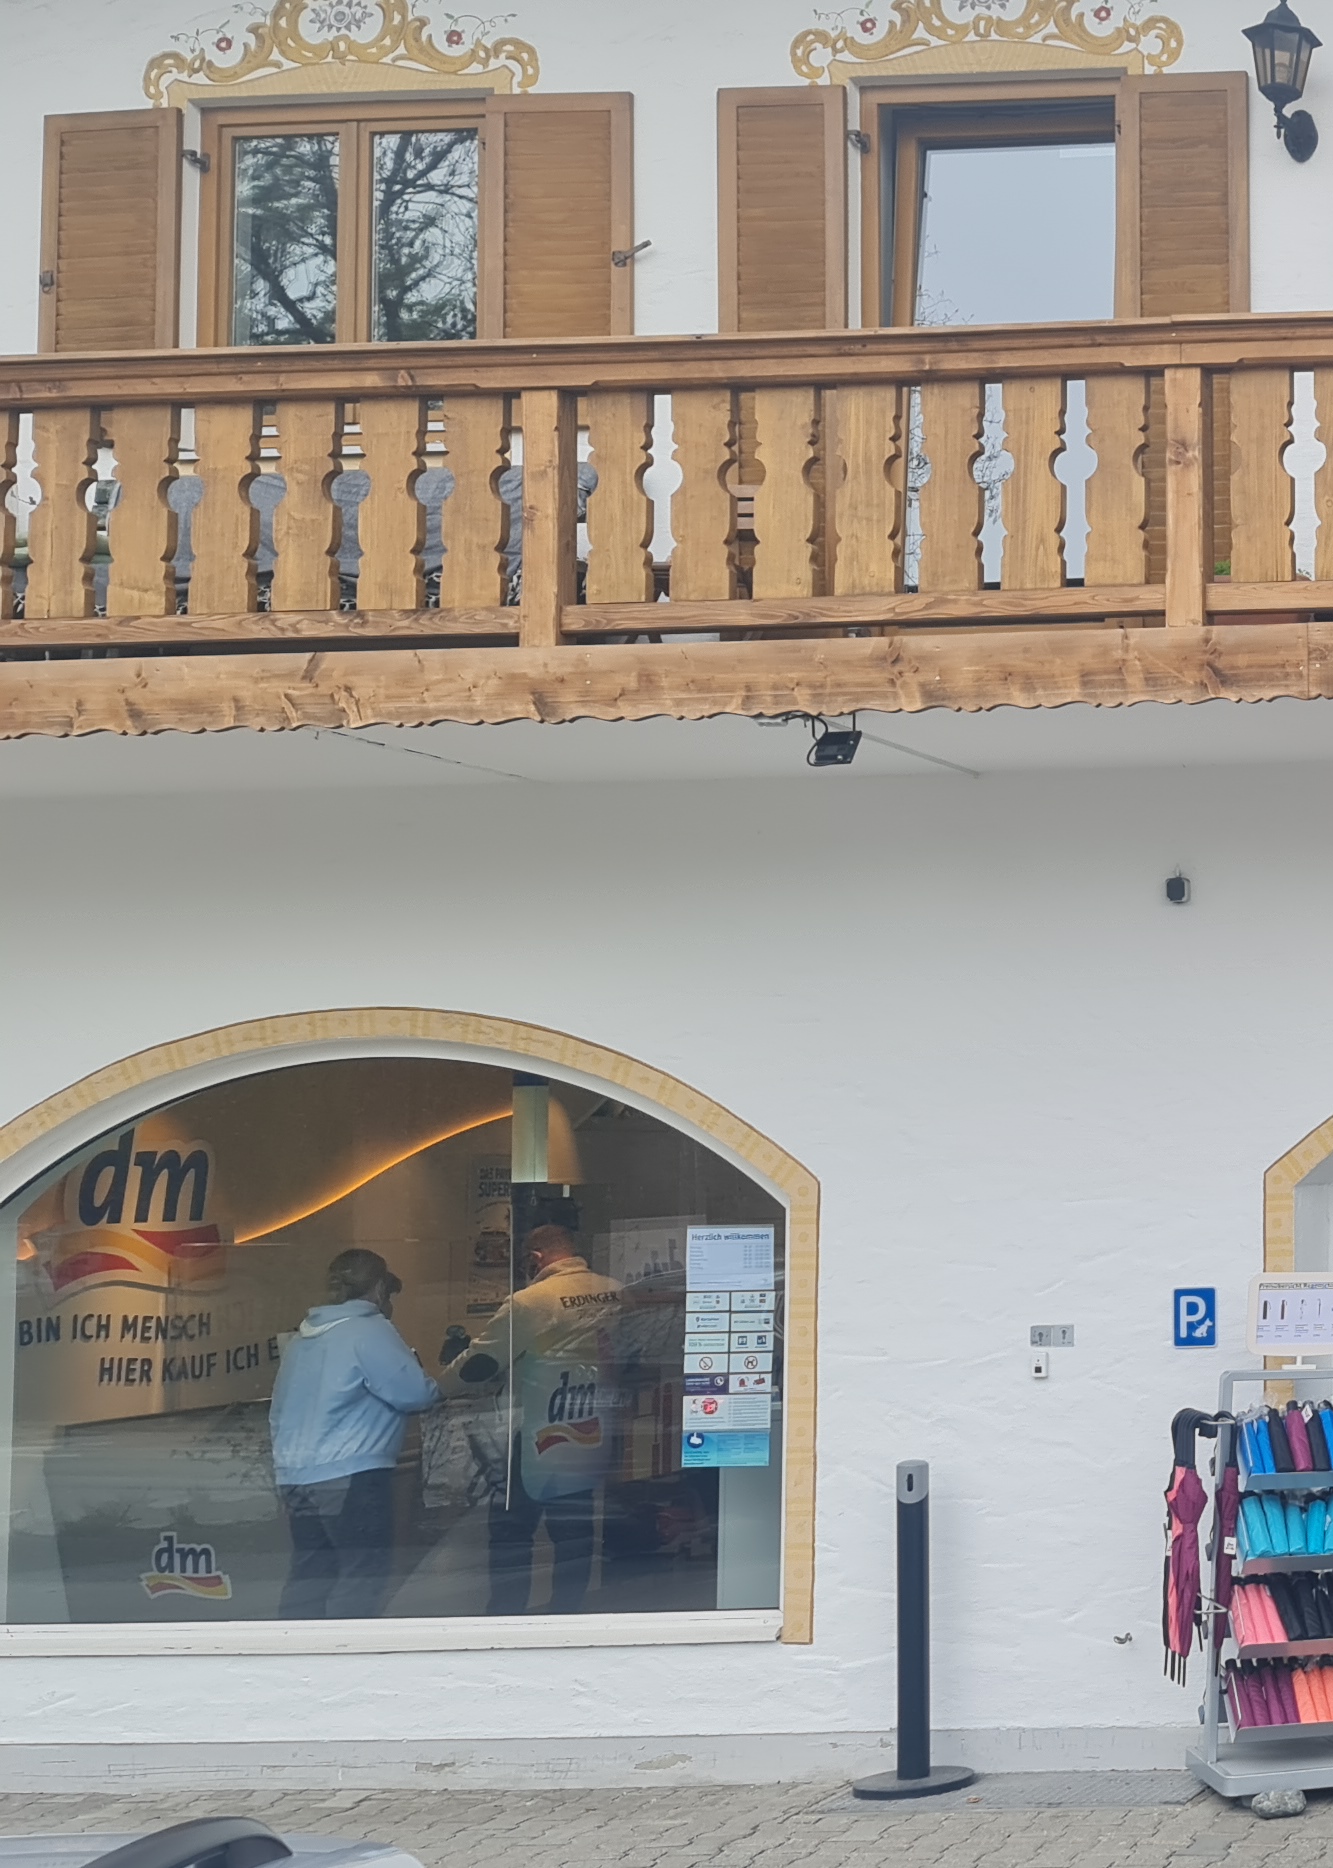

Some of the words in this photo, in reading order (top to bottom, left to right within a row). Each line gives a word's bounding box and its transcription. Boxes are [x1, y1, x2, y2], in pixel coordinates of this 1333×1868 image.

[78, 1127, 209, 1227] dm
[691, 1232, 722, 1241] Herzlich
[723, 1233, 770, 1241] willkommen
[559, 1290, 620, 1309] ERDINGER
[1179, 1295, 1206, 1339] P
[18, 1315, 61, 1347] BIN
[71, 1313, 112, 1341] ICH
[119, 1311, 212, 1343] MENSCH
[98, 1356, 153, 1385] HIER
[161, 1351, 218, 1383] KAUF
[225, 1342, 260, 1374] ICH
[547, 1370, 596, 1424] dm
[154, 1534, 213, 1574] dm
